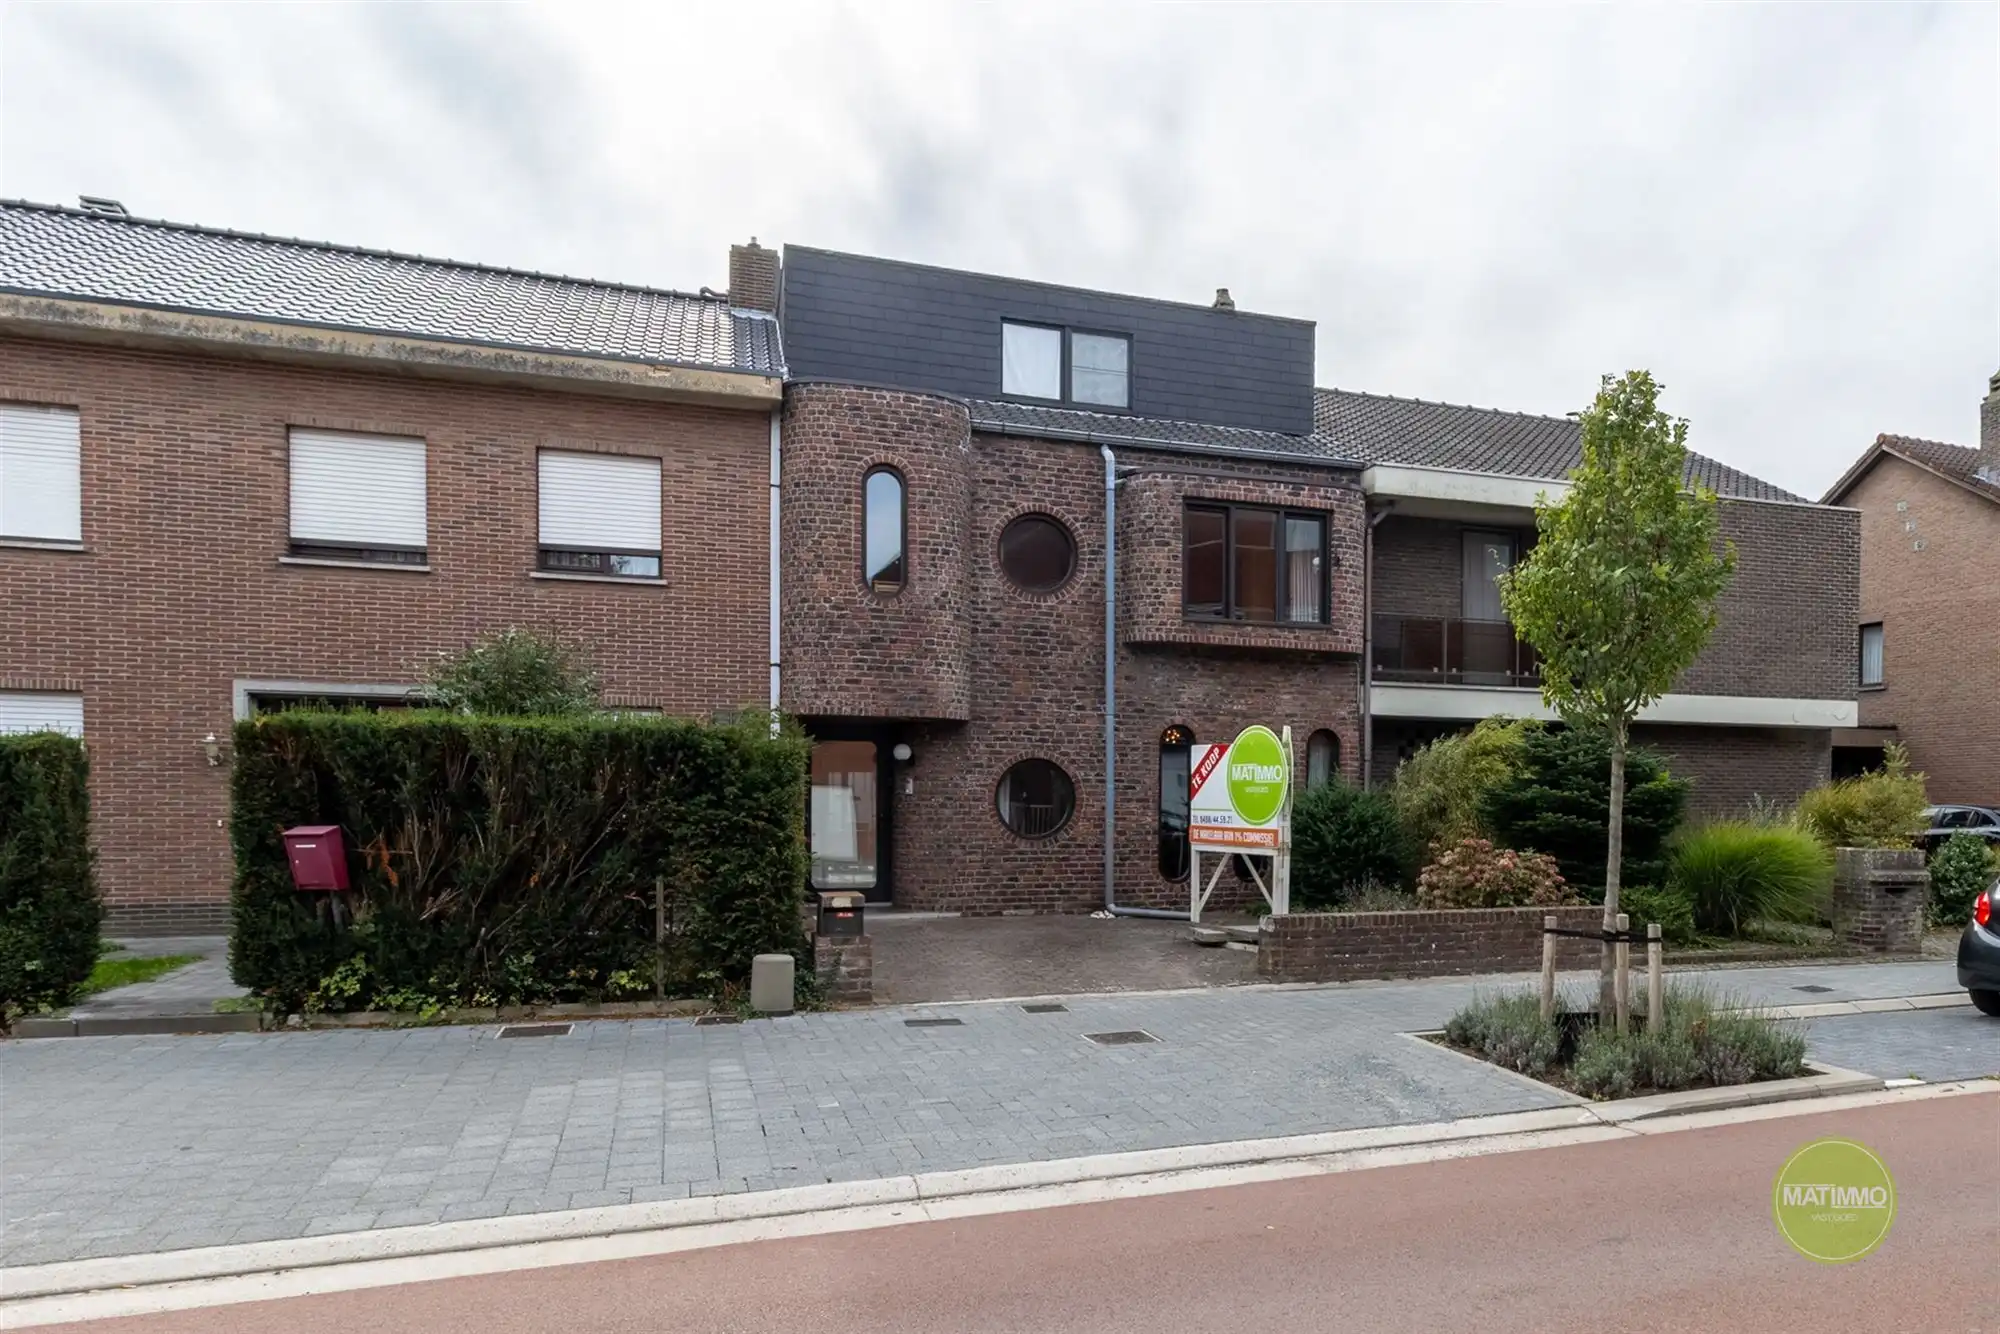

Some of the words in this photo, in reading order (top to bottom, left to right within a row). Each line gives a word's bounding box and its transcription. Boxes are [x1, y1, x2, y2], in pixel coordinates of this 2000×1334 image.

[1191, 773, 1201, 789] TE
[1200, 747, 1220, 777] KOOP
[1232, 764, 1282, 781] MATIMMO
